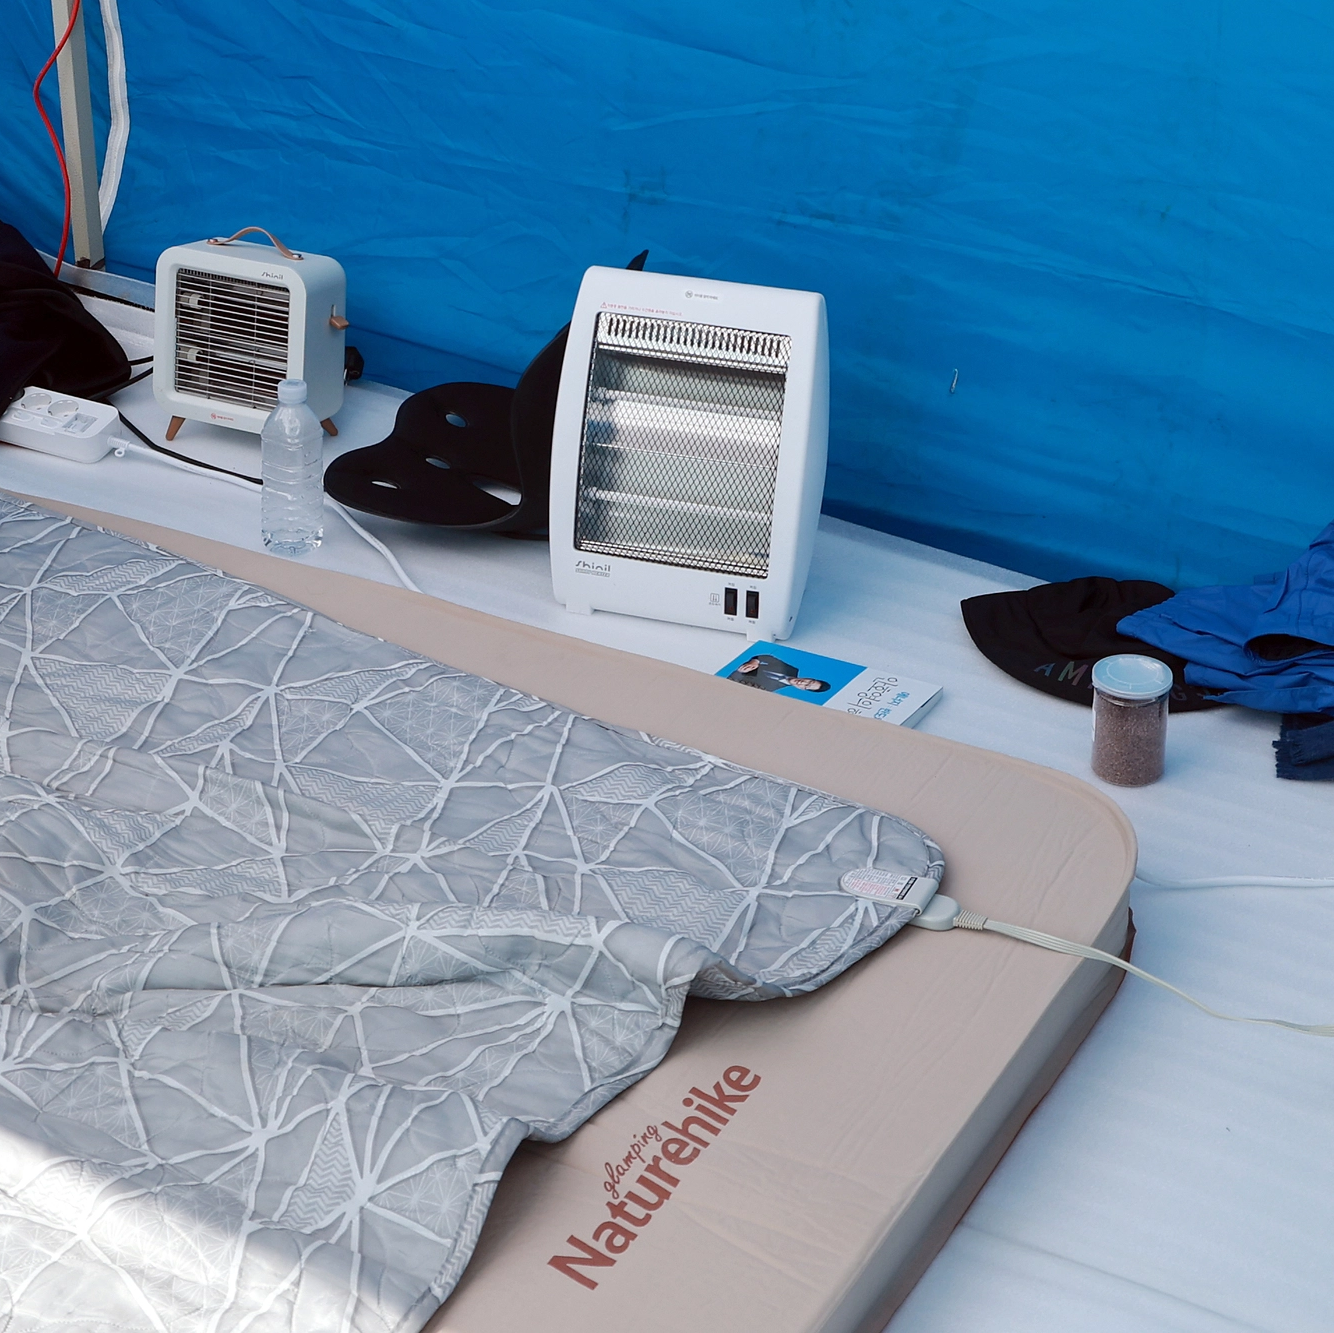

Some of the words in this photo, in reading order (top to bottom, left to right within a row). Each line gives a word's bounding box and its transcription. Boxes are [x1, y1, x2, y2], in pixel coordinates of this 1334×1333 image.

[575, 560, 611, 572] Shinil
[547, 1065, 762, 1291] Naturehike
[603, 1124, 664, 1200] glamping
